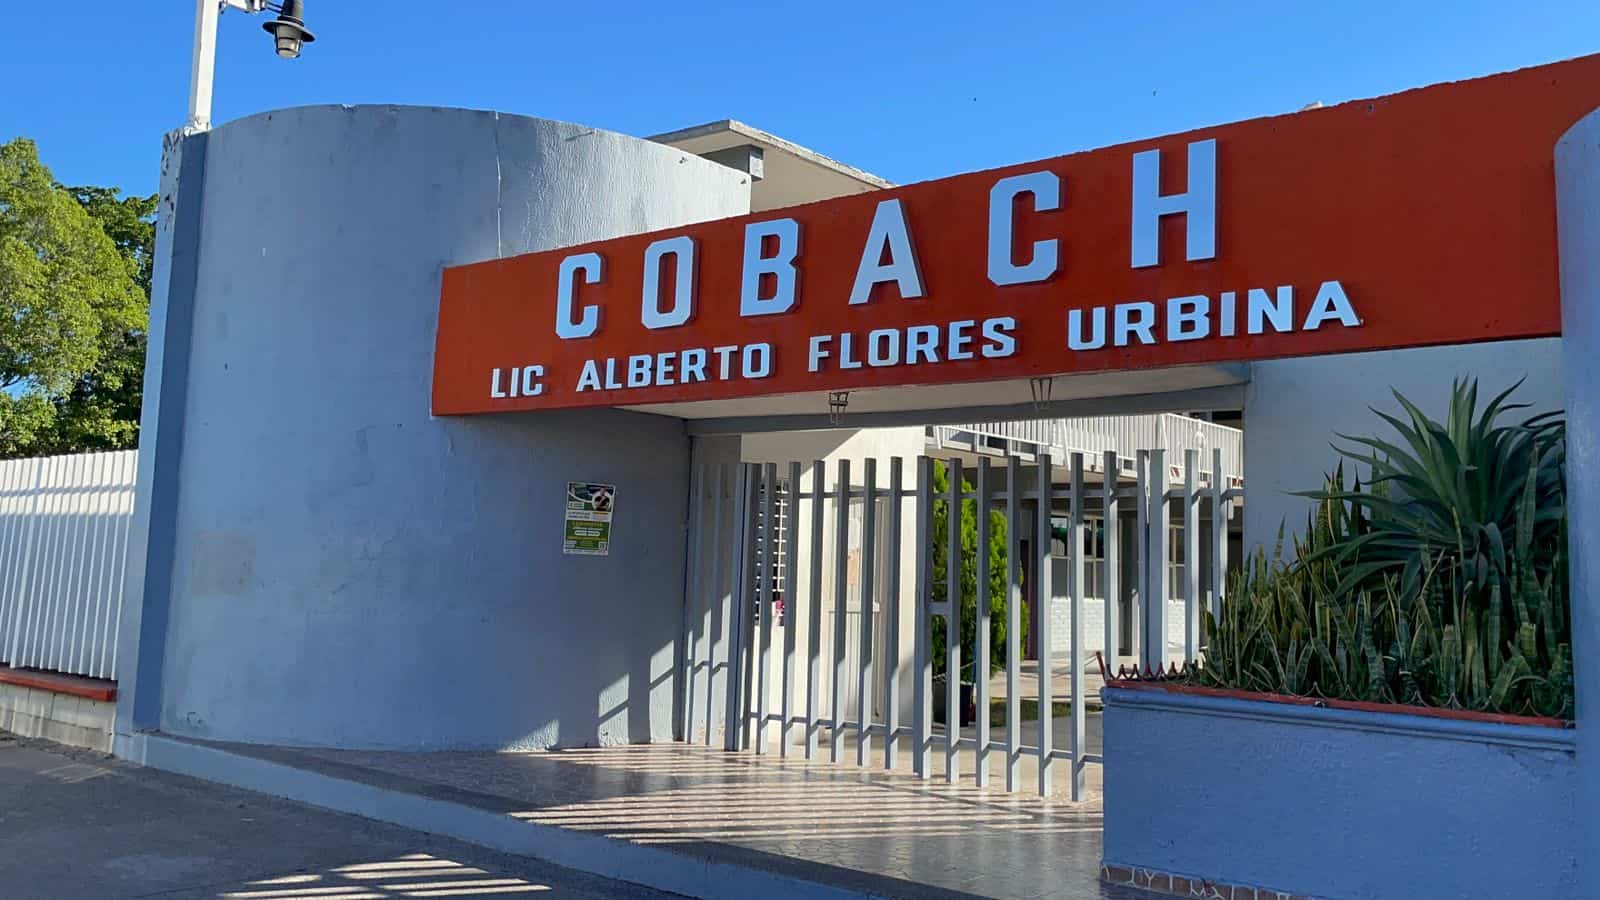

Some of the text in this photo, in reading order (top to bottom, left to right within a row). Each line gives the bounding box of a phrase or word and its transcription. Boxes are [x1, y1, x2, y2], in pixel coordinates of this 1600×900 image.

[555, 138, 1217, 340] COBACH
[490, 280, 1360, 398] LIC ALBERTO FLORES URBINA
